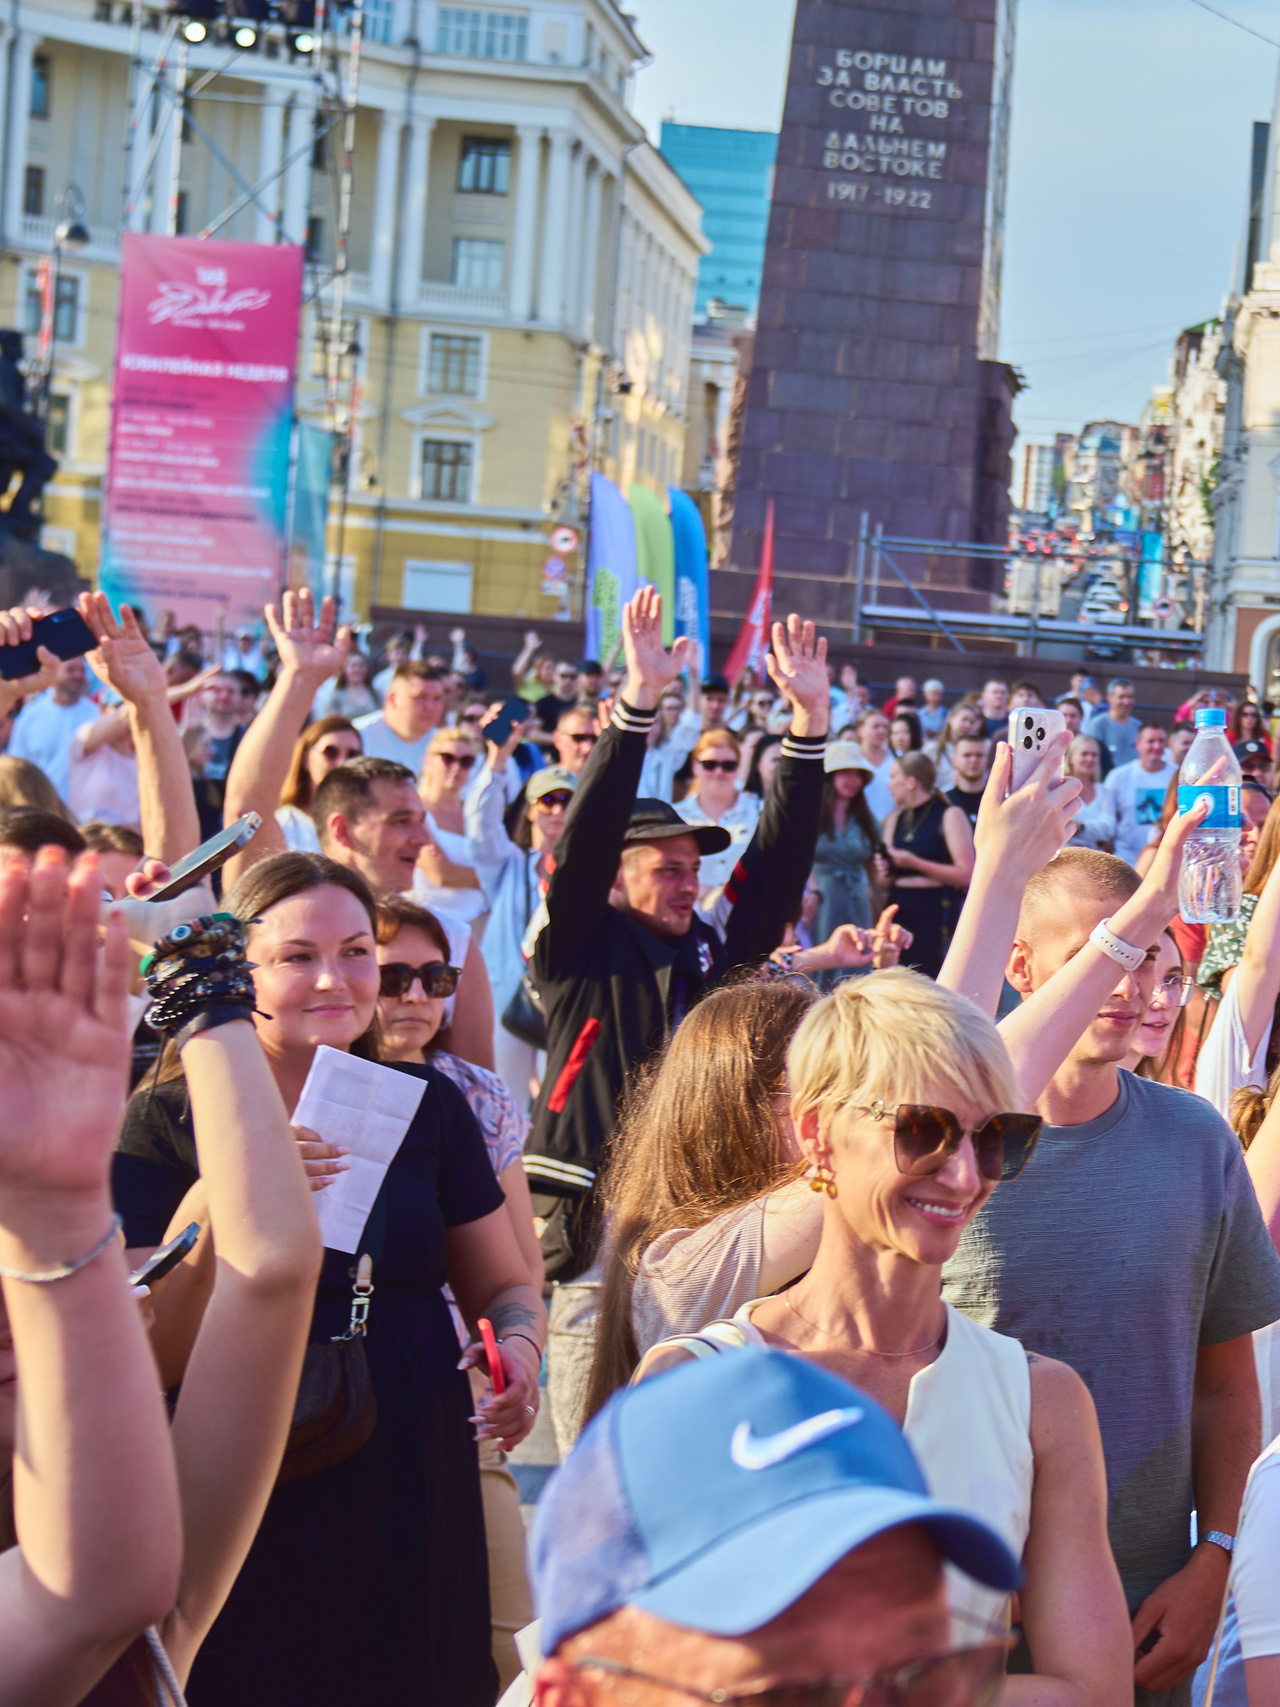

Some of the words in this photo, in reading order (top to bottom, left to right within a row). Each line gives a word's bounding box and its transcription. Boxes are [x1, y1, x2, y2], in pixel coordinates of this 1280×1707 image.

[836, 49, 946, 77] БОРЦАМ
[816, 65, 851, 88] ЗА
[864, 71, 963, 99] ВЛАСТЬ
[829, 88, 949, 119] СОВЕТОВ
[869, 113, 904, 134] НА
[824, 130, 947, 160] ДАЛЬНЕМ
[823, 149, 943, 179] ВОСТОКЕ
